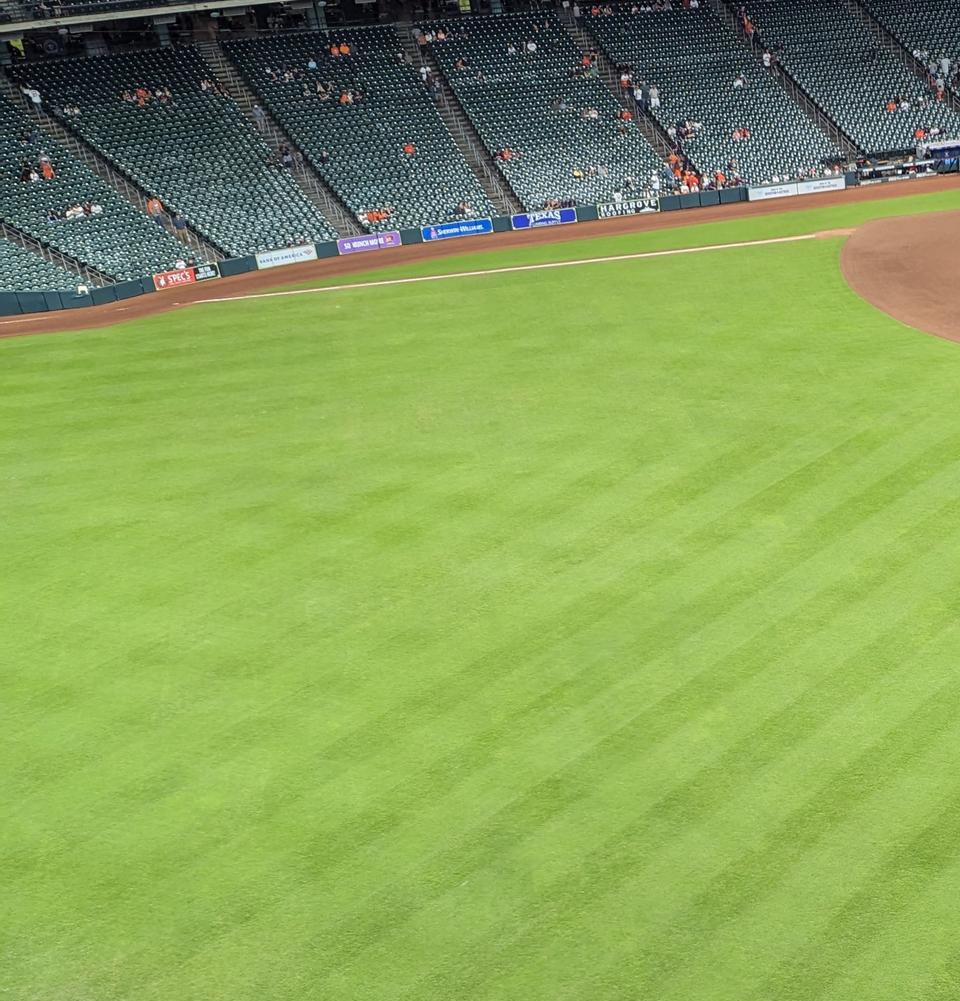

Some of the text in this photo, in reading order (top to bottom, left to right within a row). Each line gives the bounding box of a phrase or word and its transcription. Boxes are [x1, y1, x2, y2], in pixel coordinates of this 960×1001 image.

[600, 199, 657, 213] HARGROVE
[528, 209, 561, 223] TEXAS
[281, 252, 304, 260] AMERICA
[167, 270, 191, 284] SPEC'S
